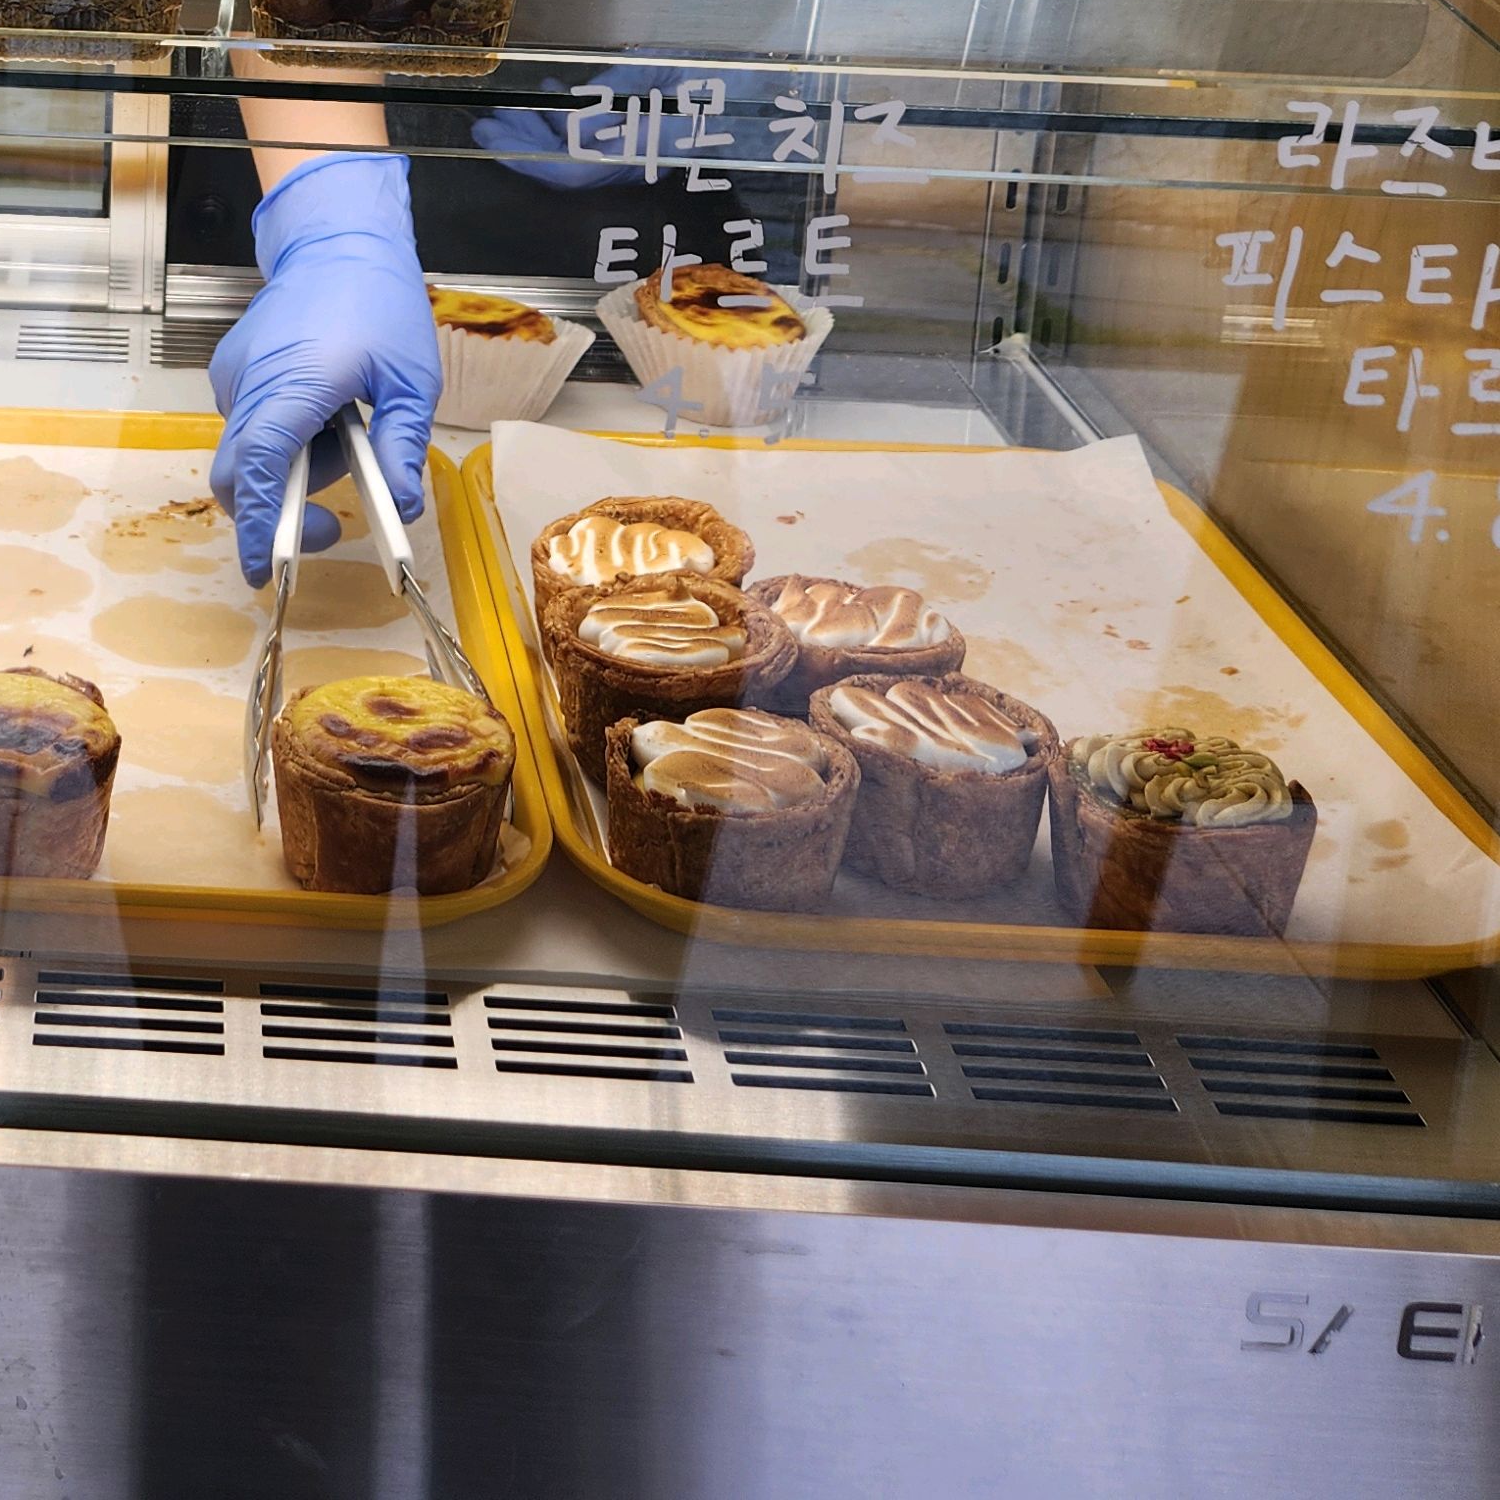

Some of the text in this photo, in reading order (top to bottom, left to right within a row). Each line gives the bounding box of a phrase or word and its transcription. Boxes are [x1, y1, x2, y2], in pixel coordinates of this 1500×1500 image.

[594, 214, 864, 308] 타르트
[1215, 226, 1500, 332] 피스타
[1365, 470, 1500, 548] 4.
